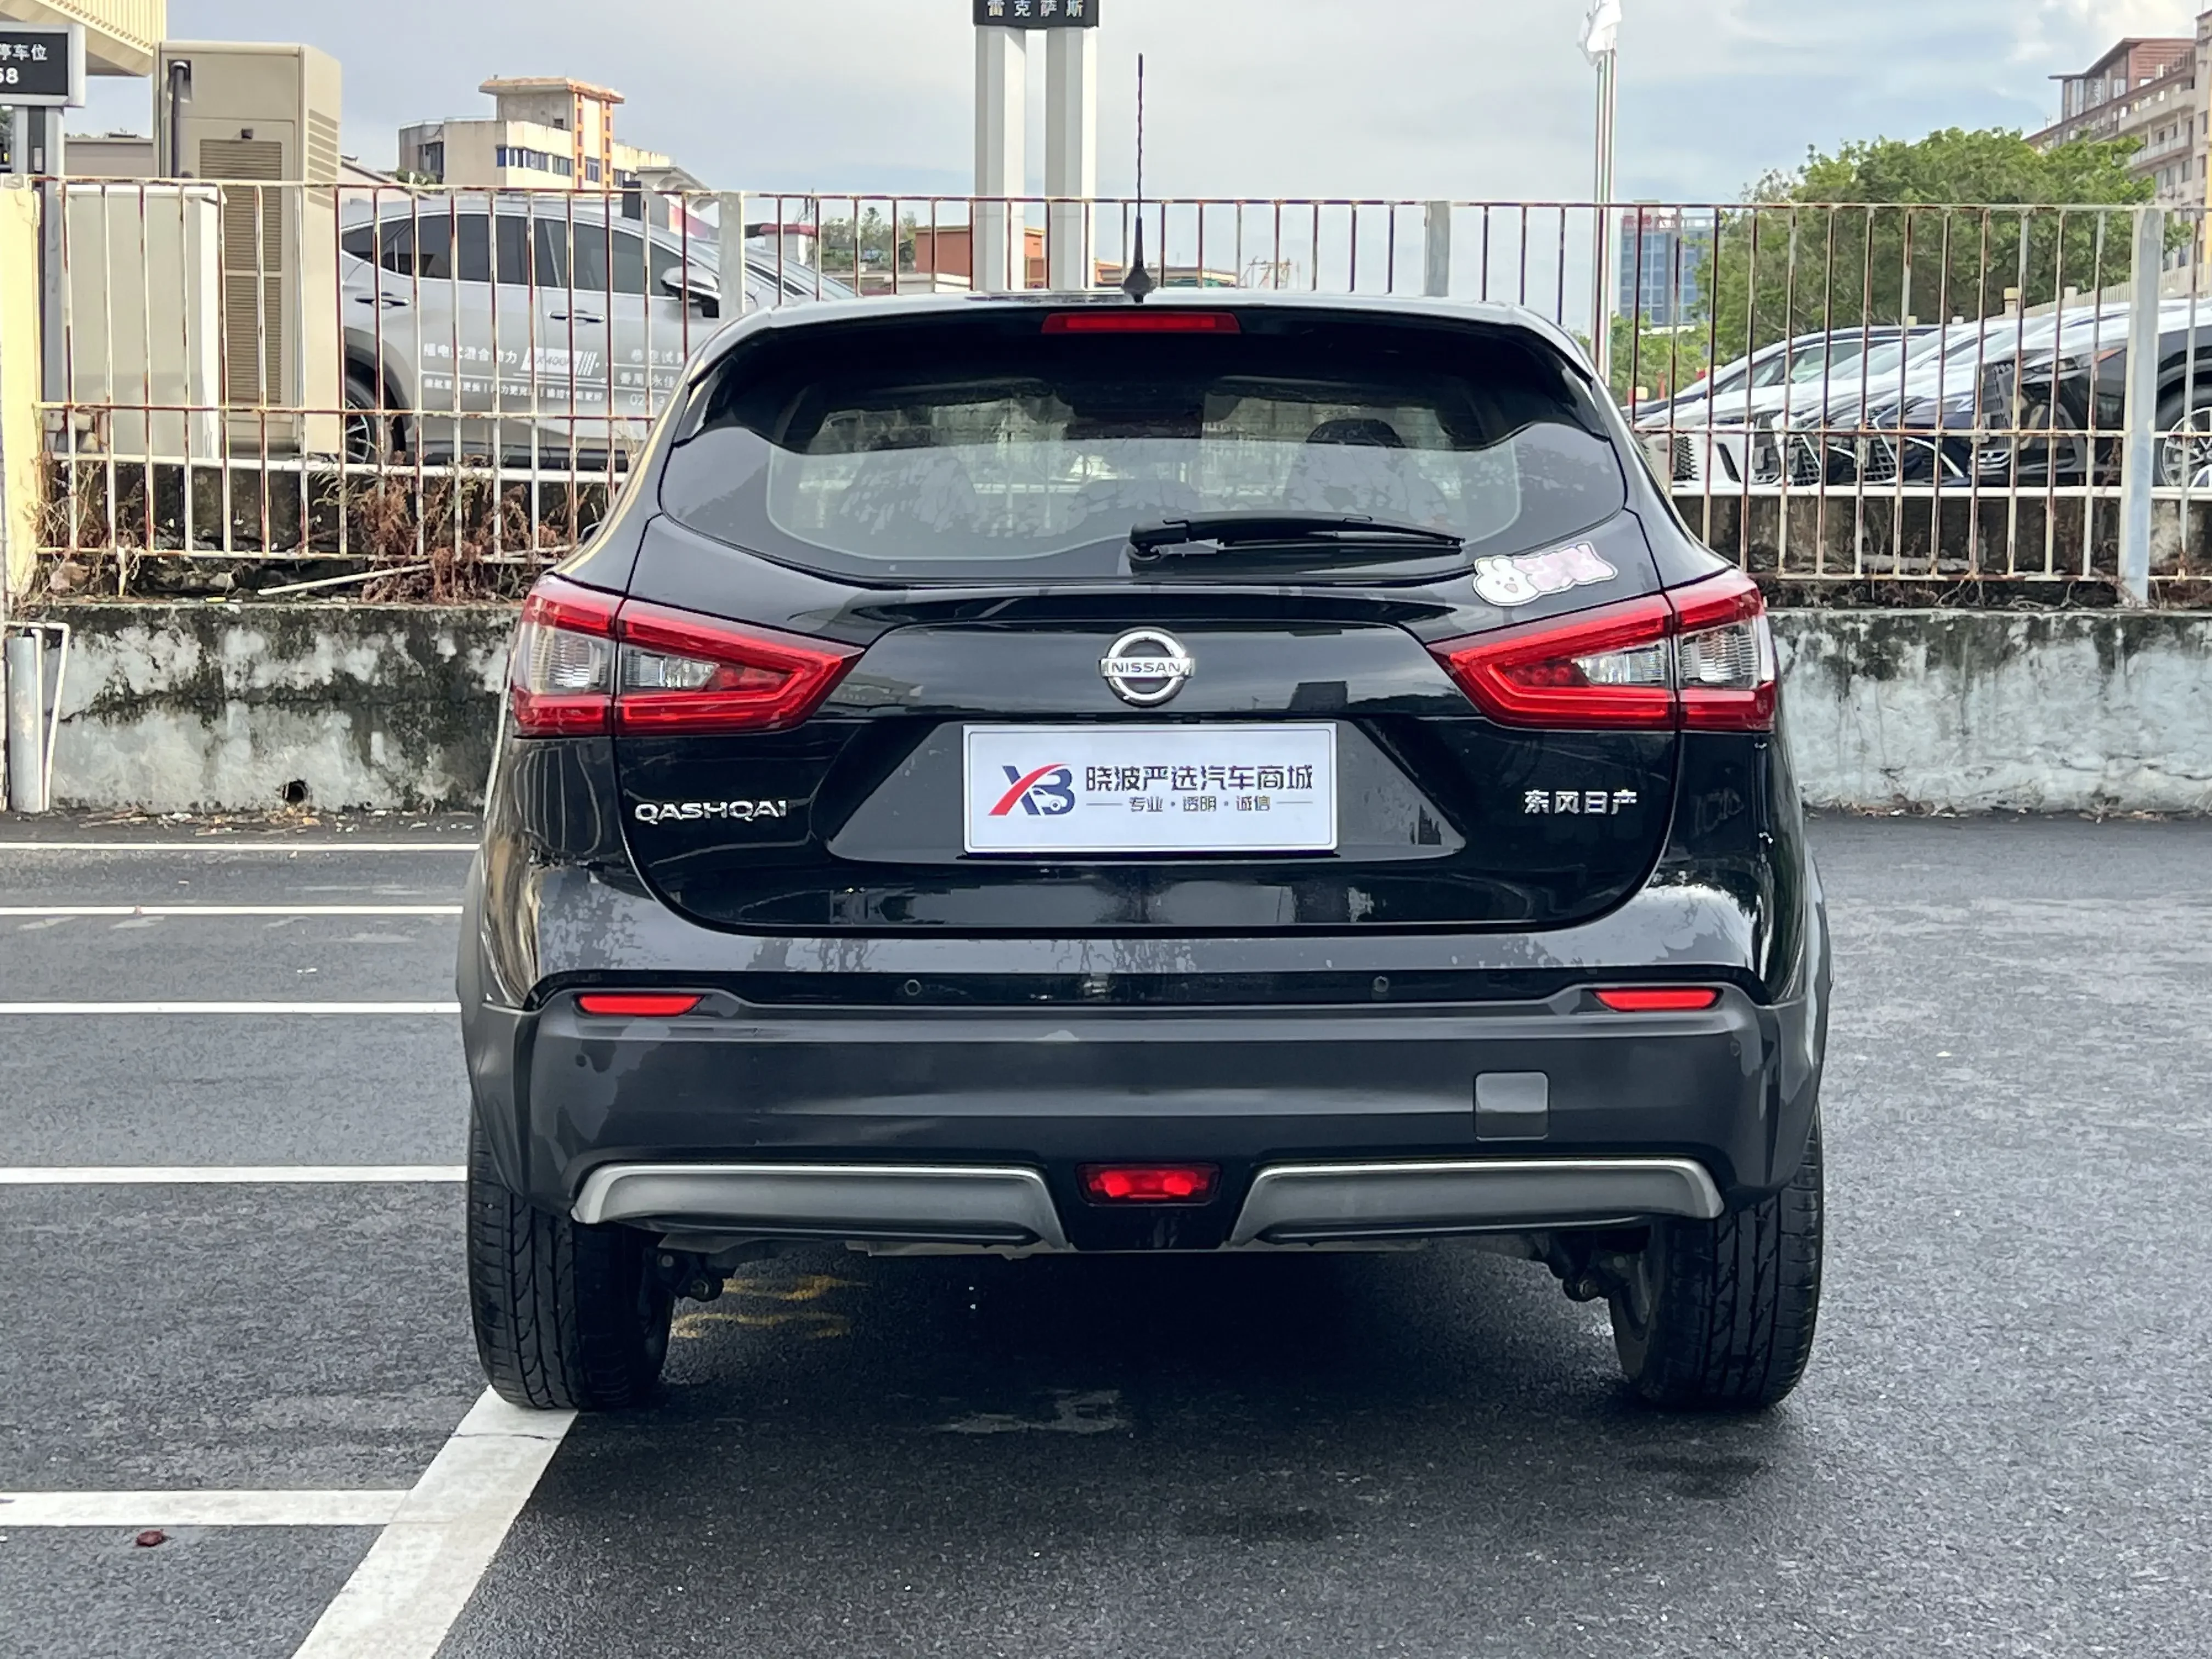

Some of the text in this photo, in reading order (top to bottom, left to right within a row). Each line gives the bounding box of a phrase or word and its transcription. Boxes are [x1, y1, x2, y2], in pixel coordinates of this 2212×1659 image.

[987, 0, 1084, 17] 雷克萨斯
[1111, 662, 1181, 673] NISSAN
[1086, 764, 1313, 791] 晓波严选汽车商城
[634, 800, 787, 825] QASHQAI
[1524, 789, 1637, 815] 东风日产
